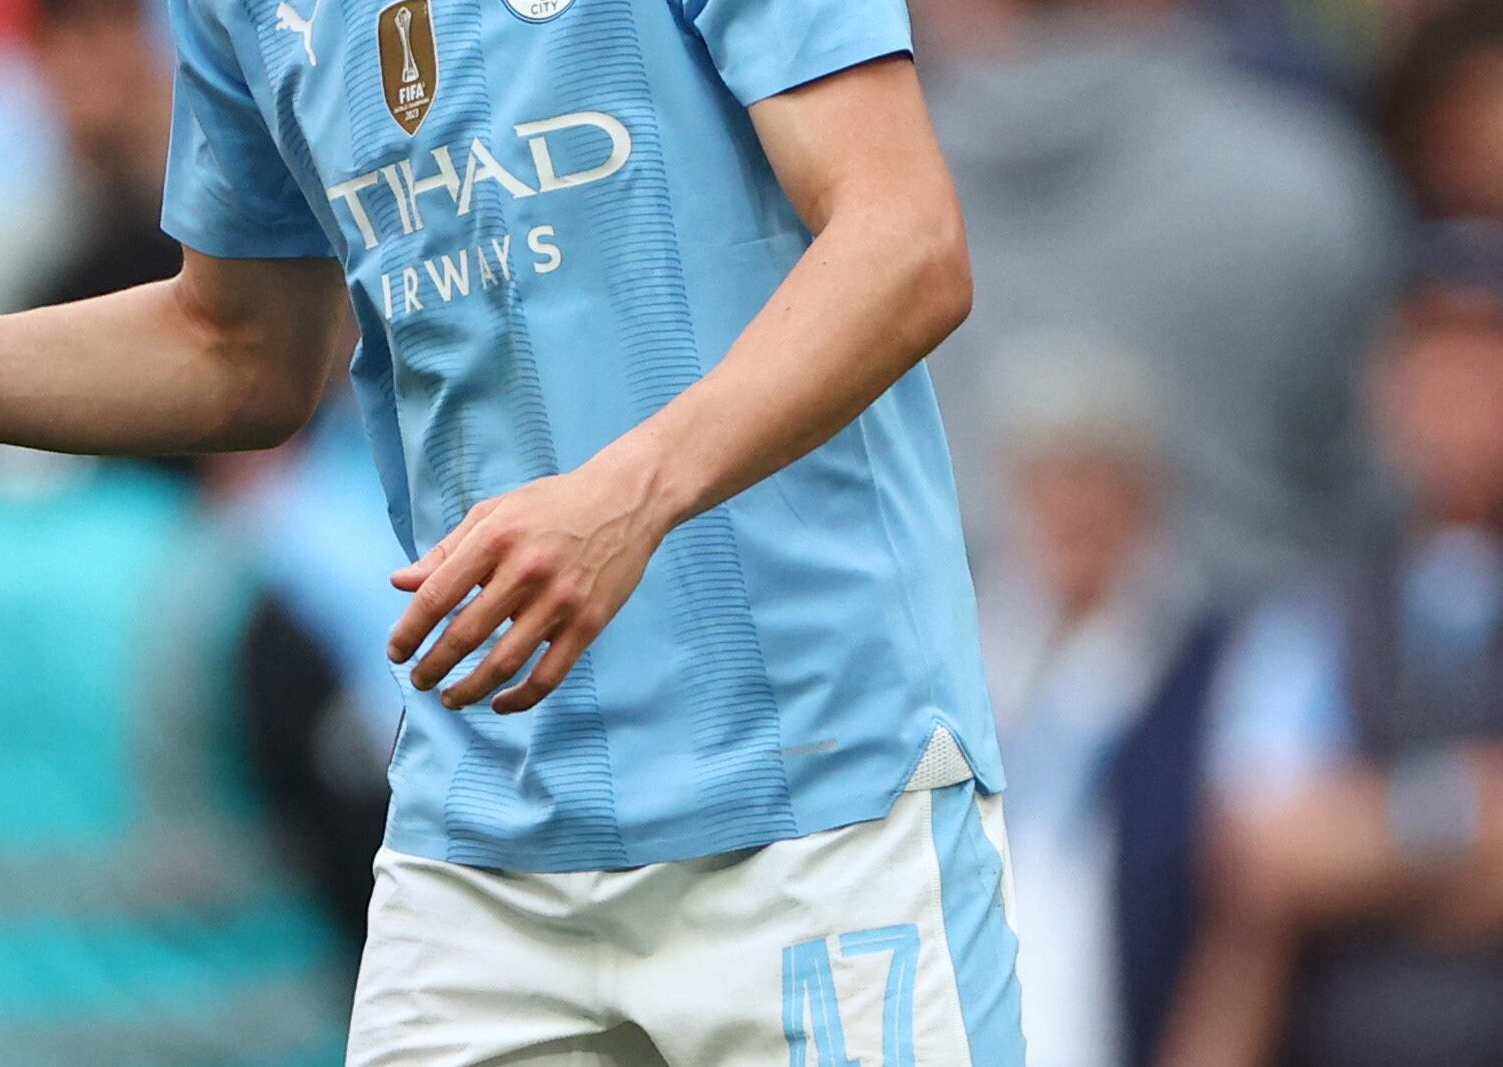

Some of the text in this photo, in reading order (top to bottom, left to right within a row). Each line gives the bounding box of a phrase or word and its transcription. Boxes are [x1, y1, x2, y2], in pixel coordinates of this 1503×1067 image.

[530, 0, 558, 15] CITY
[399, 82, 424, 104] FIFA
[328, 110, 632, 250] TIHAD
[381, 225, 563, 320] IRWAYS
[782, 922, 921, 1067] 47
